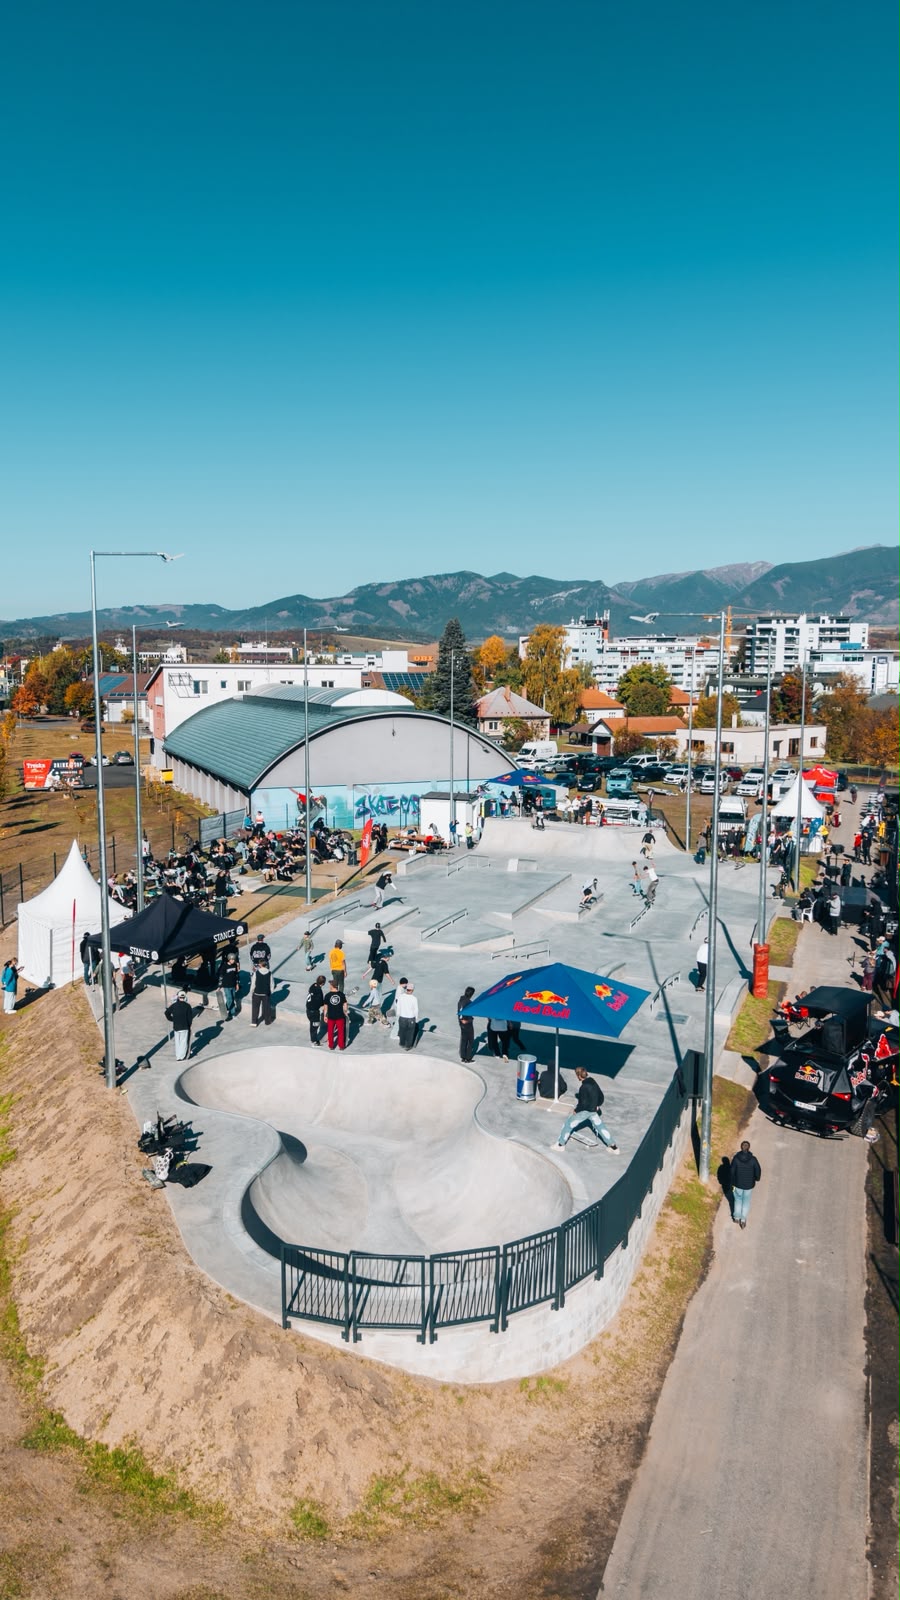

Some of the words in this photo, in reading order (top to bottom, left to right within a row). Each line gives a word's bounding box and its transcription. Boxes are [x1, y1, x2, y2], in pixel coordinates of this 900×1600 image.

[213, 929, 235, 942] STANCE
[129, 946, 150, 958] STANCE
[513, 1001, 541, 1015] Red
[541, 1006, 571, 1019] Bull
